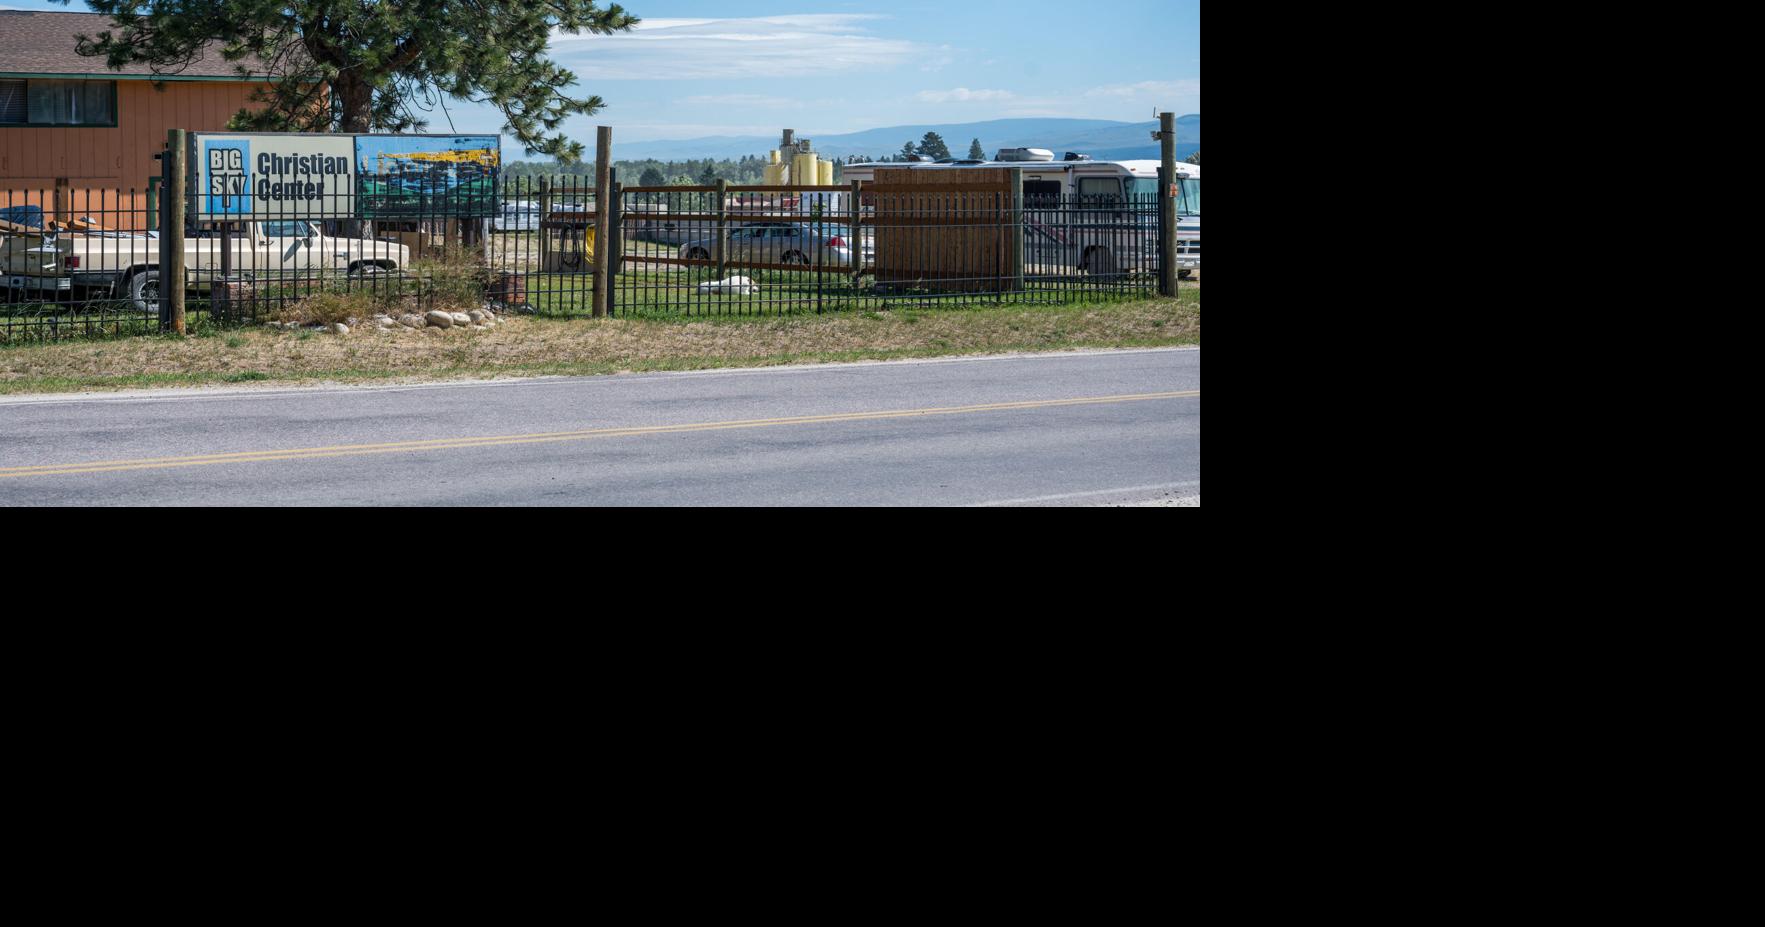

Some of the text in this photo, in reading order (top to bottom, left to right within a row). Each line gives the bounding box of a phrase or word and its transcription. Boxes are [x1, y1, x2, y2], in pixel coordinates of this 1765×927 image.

[209, 148, 243, 170] BIG
[257, 152, 349, 175] Christian
[211, 175, 248, 196] SKY
[258, 178, 325, 201] Center
